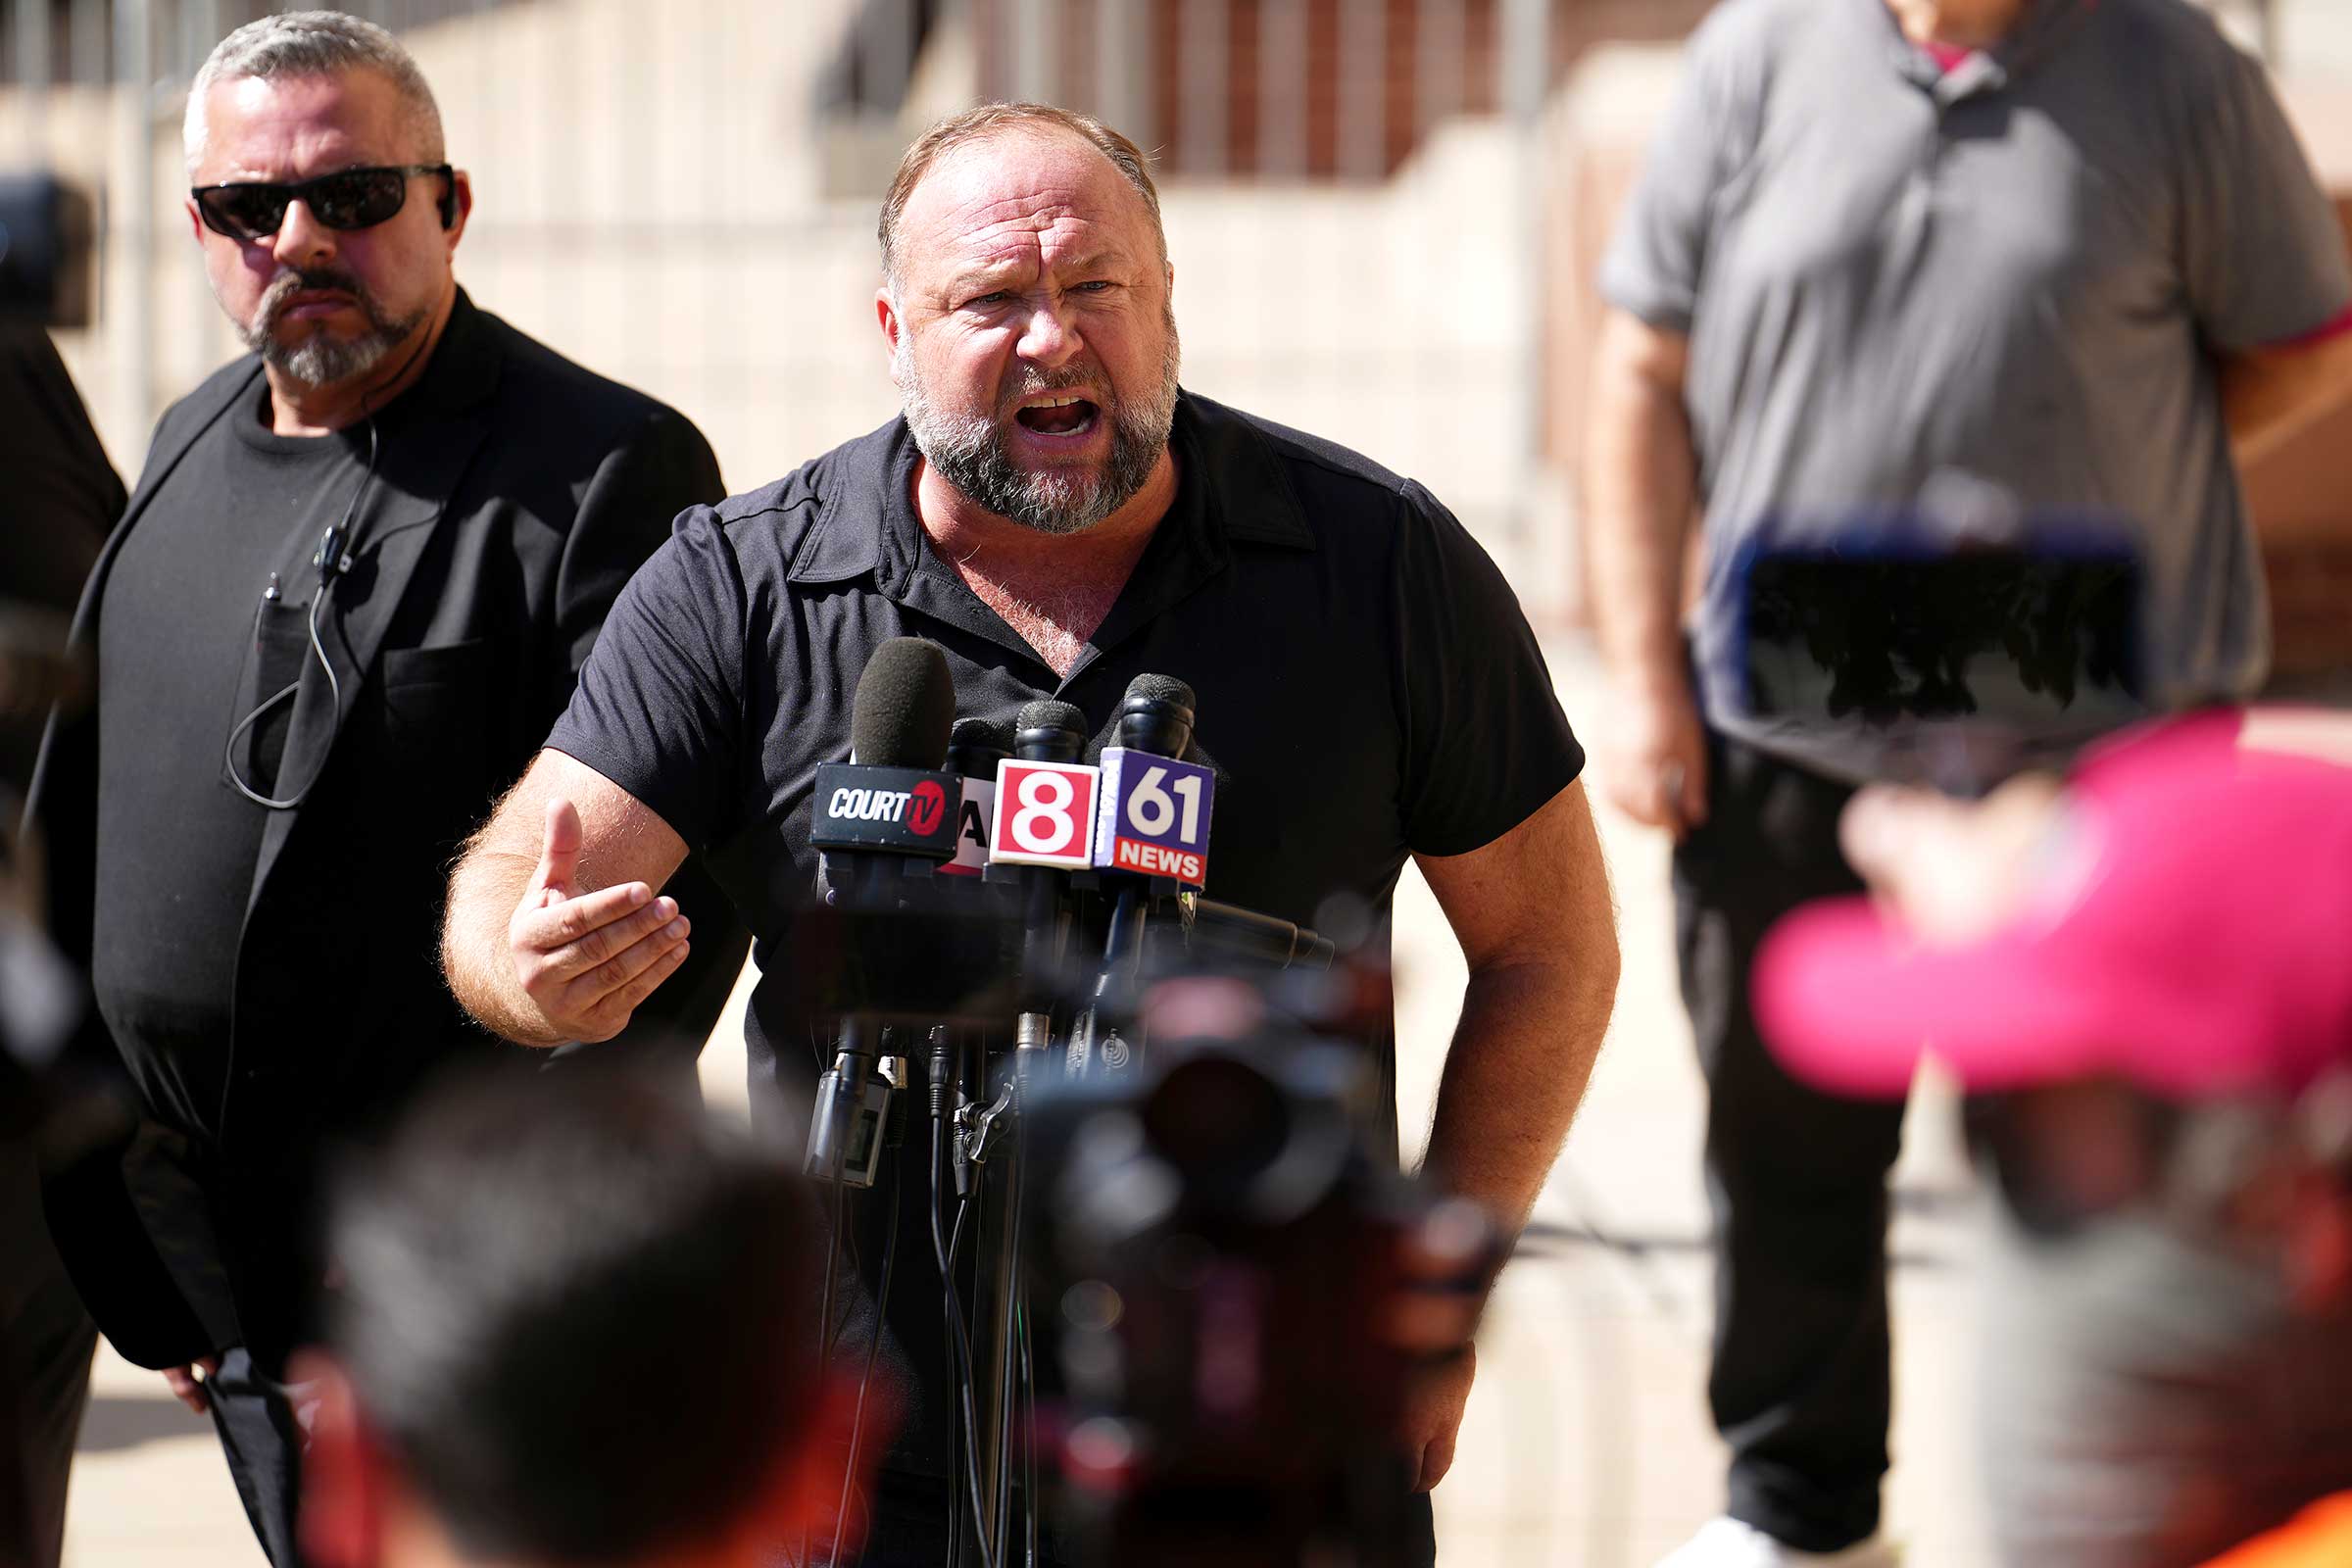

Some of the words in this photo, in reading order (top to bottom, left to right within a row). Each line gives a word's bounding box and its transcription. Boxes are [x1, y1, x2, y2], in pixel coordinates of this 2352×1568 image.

[828, 787, 911, 822] COURT
[906, 794, 940, 824] TV
[1010, 770, 1075, 854] 8
[1127, 765, 1201, 845] 61
[1119, 840, 1200, 879] NEWS
